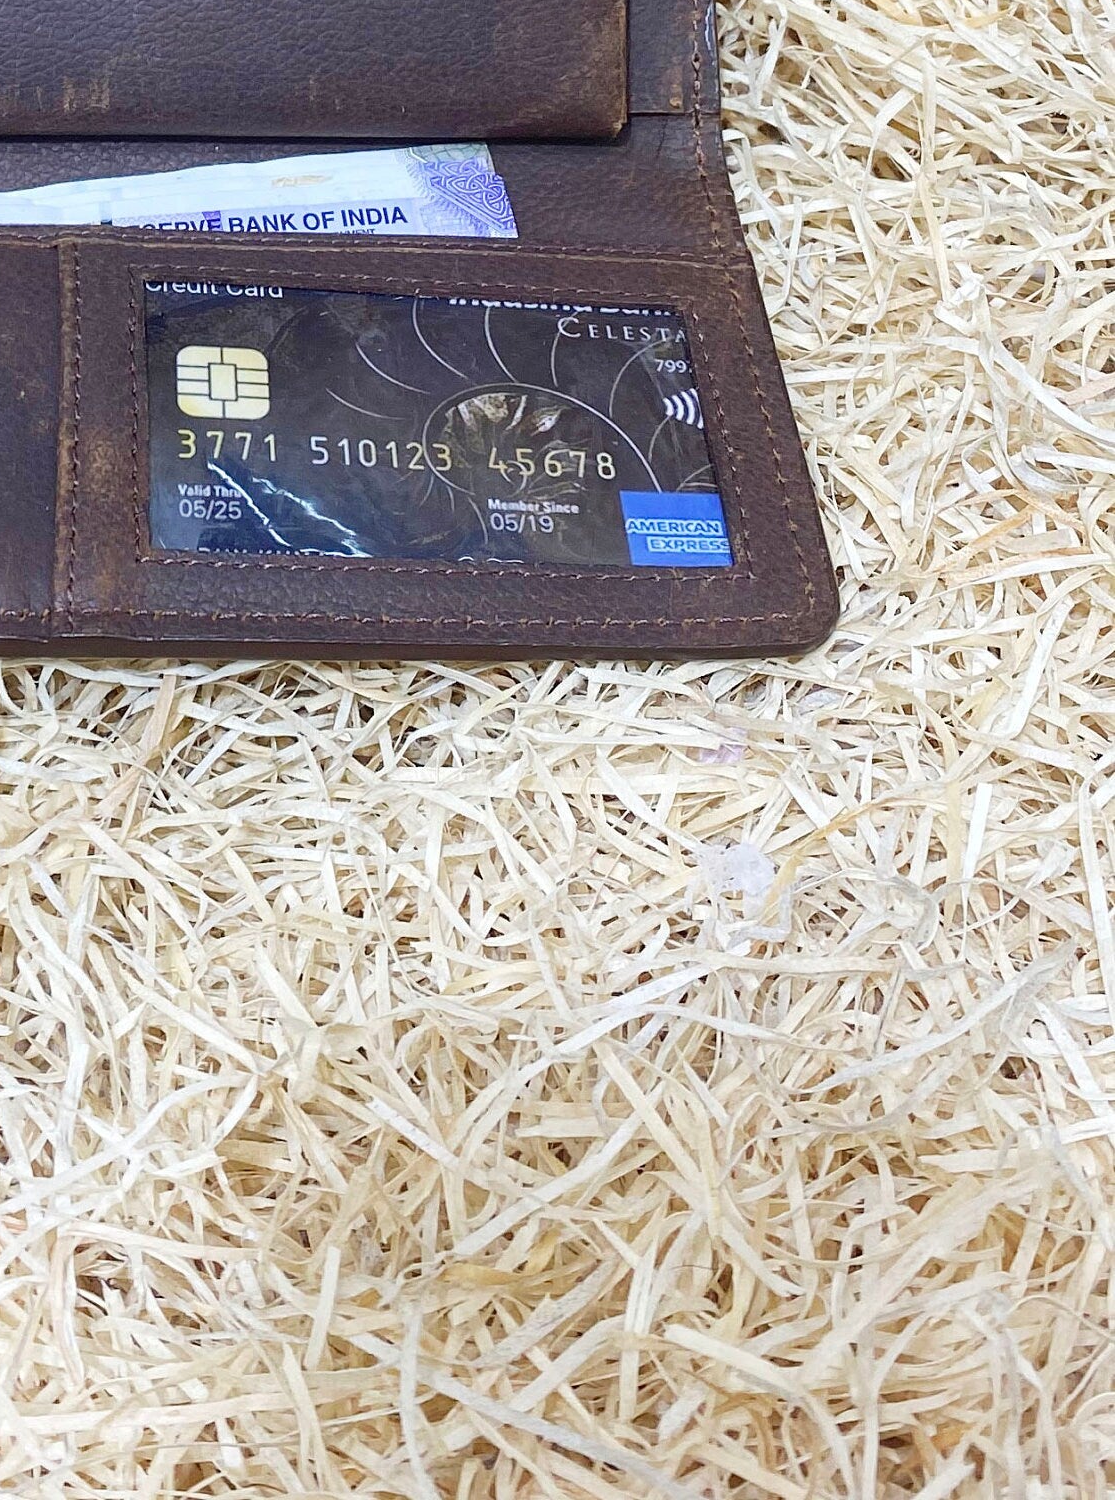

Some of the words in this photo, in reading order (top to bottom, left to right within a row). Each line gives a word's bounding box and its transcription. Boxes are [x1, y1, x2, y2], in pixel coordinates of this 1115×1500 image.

[228, 211, 297, 233] BANK
[303, 210, 335, 231] OF
[341, 206, 409, 227] INDIA
[177, 429, 277, 462] 3771
[310, 435, 453, 471] 510123
[488, 446, 617, 481] 45678
[177, 483, 212, 497] Valid
[178, 498, 243, 521] 05/25
[487, 498, 540, 512] Member
[542, 501, 581, 515] Since
[489, 512, 555, 534] 05/19
[626, 518, 723, 536] AMERICAN
[647, 536, 730, 554] EXPRESS
